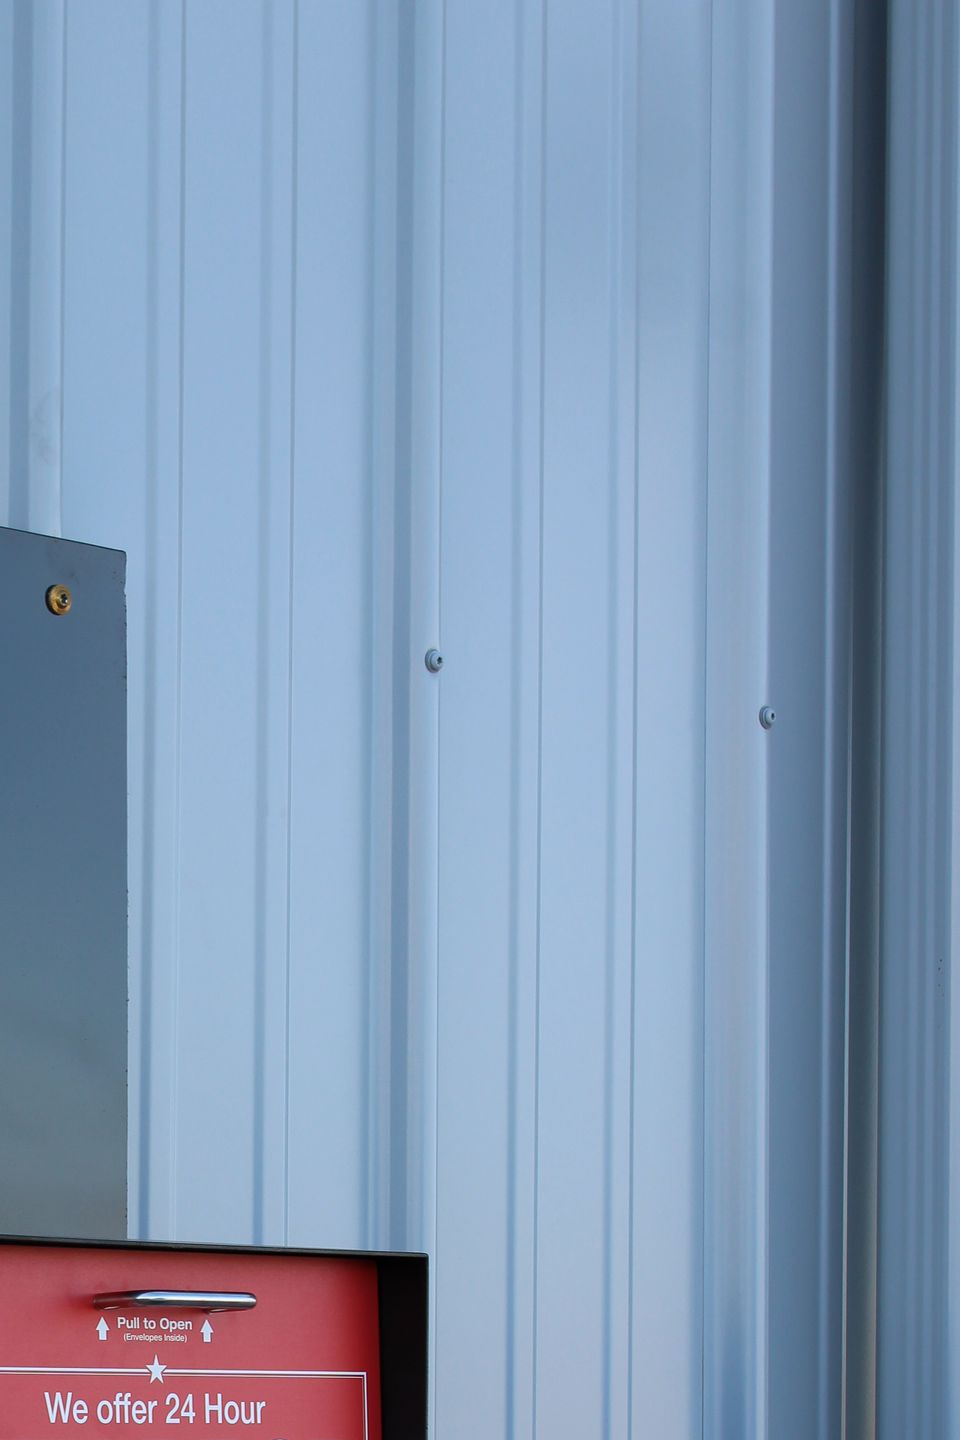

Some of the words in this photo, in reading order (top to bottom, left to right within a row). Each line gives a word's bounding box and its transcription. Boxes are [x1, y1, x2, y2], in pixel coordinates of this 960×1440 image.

[117, 1316, 140, 1329] Pull
[143, 1318, 156, 1330] to
[159, 1317, 193, 1332] Open
[123, 1333, 162, 1342] (Envelopes
[164, 1334, 188, 1343] Inside)
[44, 1392, 89, 1424] We
[96, 1392, 158, 1424] offer
[164, 1392, 197, 1424] 24
[204, 1393, 266, 1425] Hour
